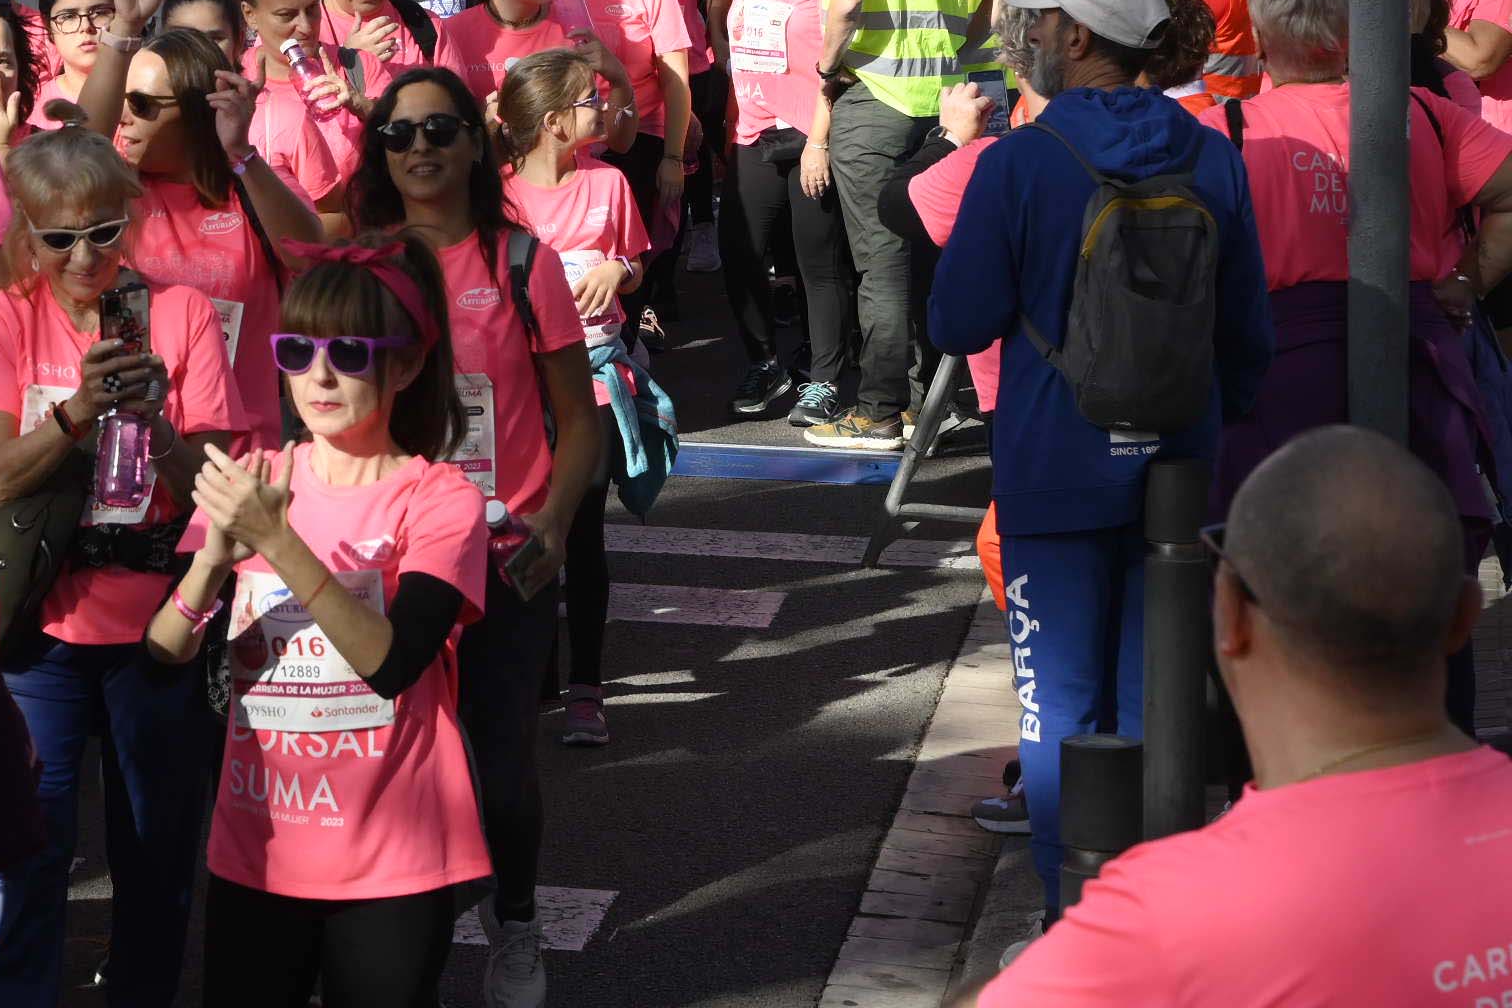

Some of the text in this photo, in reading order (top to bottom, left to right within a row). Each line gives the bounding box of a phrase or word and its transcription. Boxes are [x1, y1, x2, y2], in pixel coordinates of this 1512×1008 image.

[1314, 172, 1343, 192] DE
[1110, 446, 1139, 456] SINCE
[272, 636, 326, 658] 016
[1006, 573, 1041, 743] BARÇA
[281, 664, 321, 679] 12889
[249, 684, 284, 694] ARRERA
[287, 684, 298, 694] DE
[299, 684, 312, 695] LA
[312, 683, 347, 695] MUJER
[324, 704, 380, 718] Santander
[229, 759, 341, 813] SUMA
[319, 815, 345, 828] 2023
